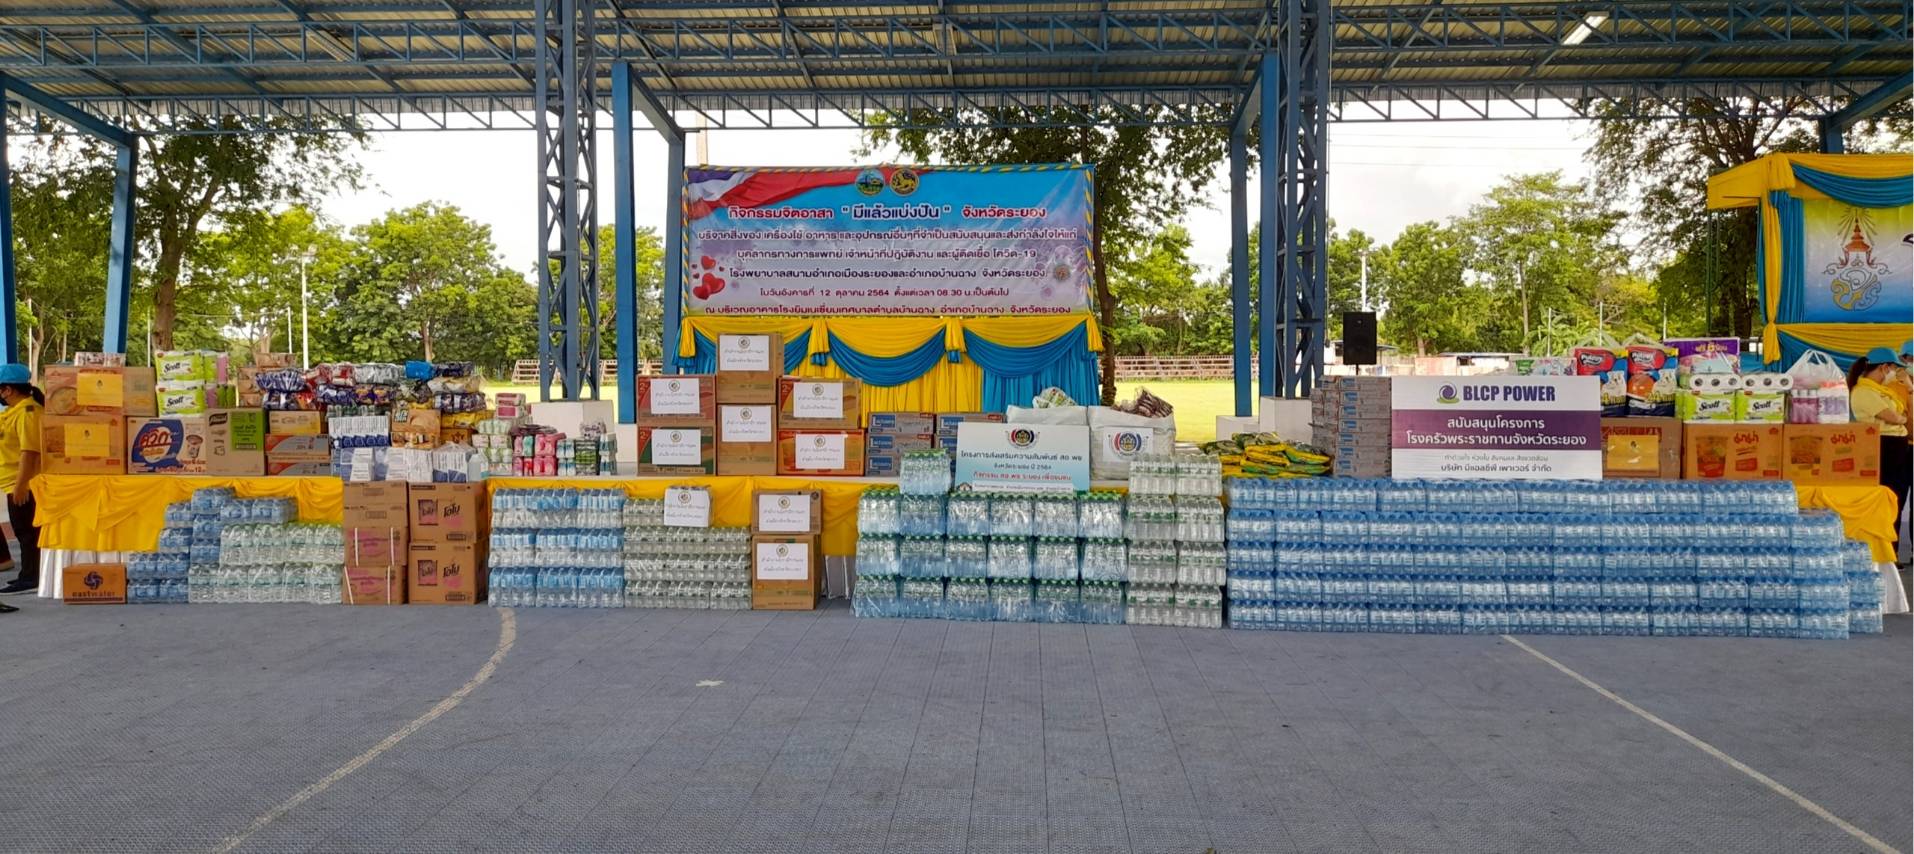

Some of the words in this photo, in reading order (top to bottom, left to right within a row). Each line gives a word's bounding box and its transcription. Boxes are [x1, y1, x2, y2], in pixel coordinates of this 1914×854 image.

[729, 206, 833, 219] กิจกรรมจิตอาสา
[853, 205, 939, 219] มีแล้วแบ่งปัน
[963, 207, 1046, 218] จังหวัดระยอง
[699, 229, 761, 240] บริจาคสิ่งของ
[806, 232, 837, 240] อาหาร
[738, 250, 843, 261] บุคลากรทางการแพทย์
[846, 249, 934, 261] เจ้าหน้าที่ปฏิบัติงาน
[936, 246, 990, 261] และผู้ติดเชื้อ
[993, 249, 1036, 258] โควิด-19
[982, 268, 1046, 278] จังหวัดระยอง
[836, 289, 865, 298] ตุลาคม
[1010, 304, 1071, 314] จังหวัดระยอง
[164, 362, 181, 373] Scott
[1463, 386, 1500, 401] BLCP
[1503, 386, 1556, 401] POWER
[167, 396, 184, 406] Scott
[1698, 400, 1720, 411] Scott
[1752, 400, 1771, 411] Scott
[1447, 415, 1545, 432] สนับสนุนโครงการ
[1407, 430, 1587, 445] โรงครัวพระราชทานจังหวัดระยอง
[1441, 464, 1463, 473] บริษัท
